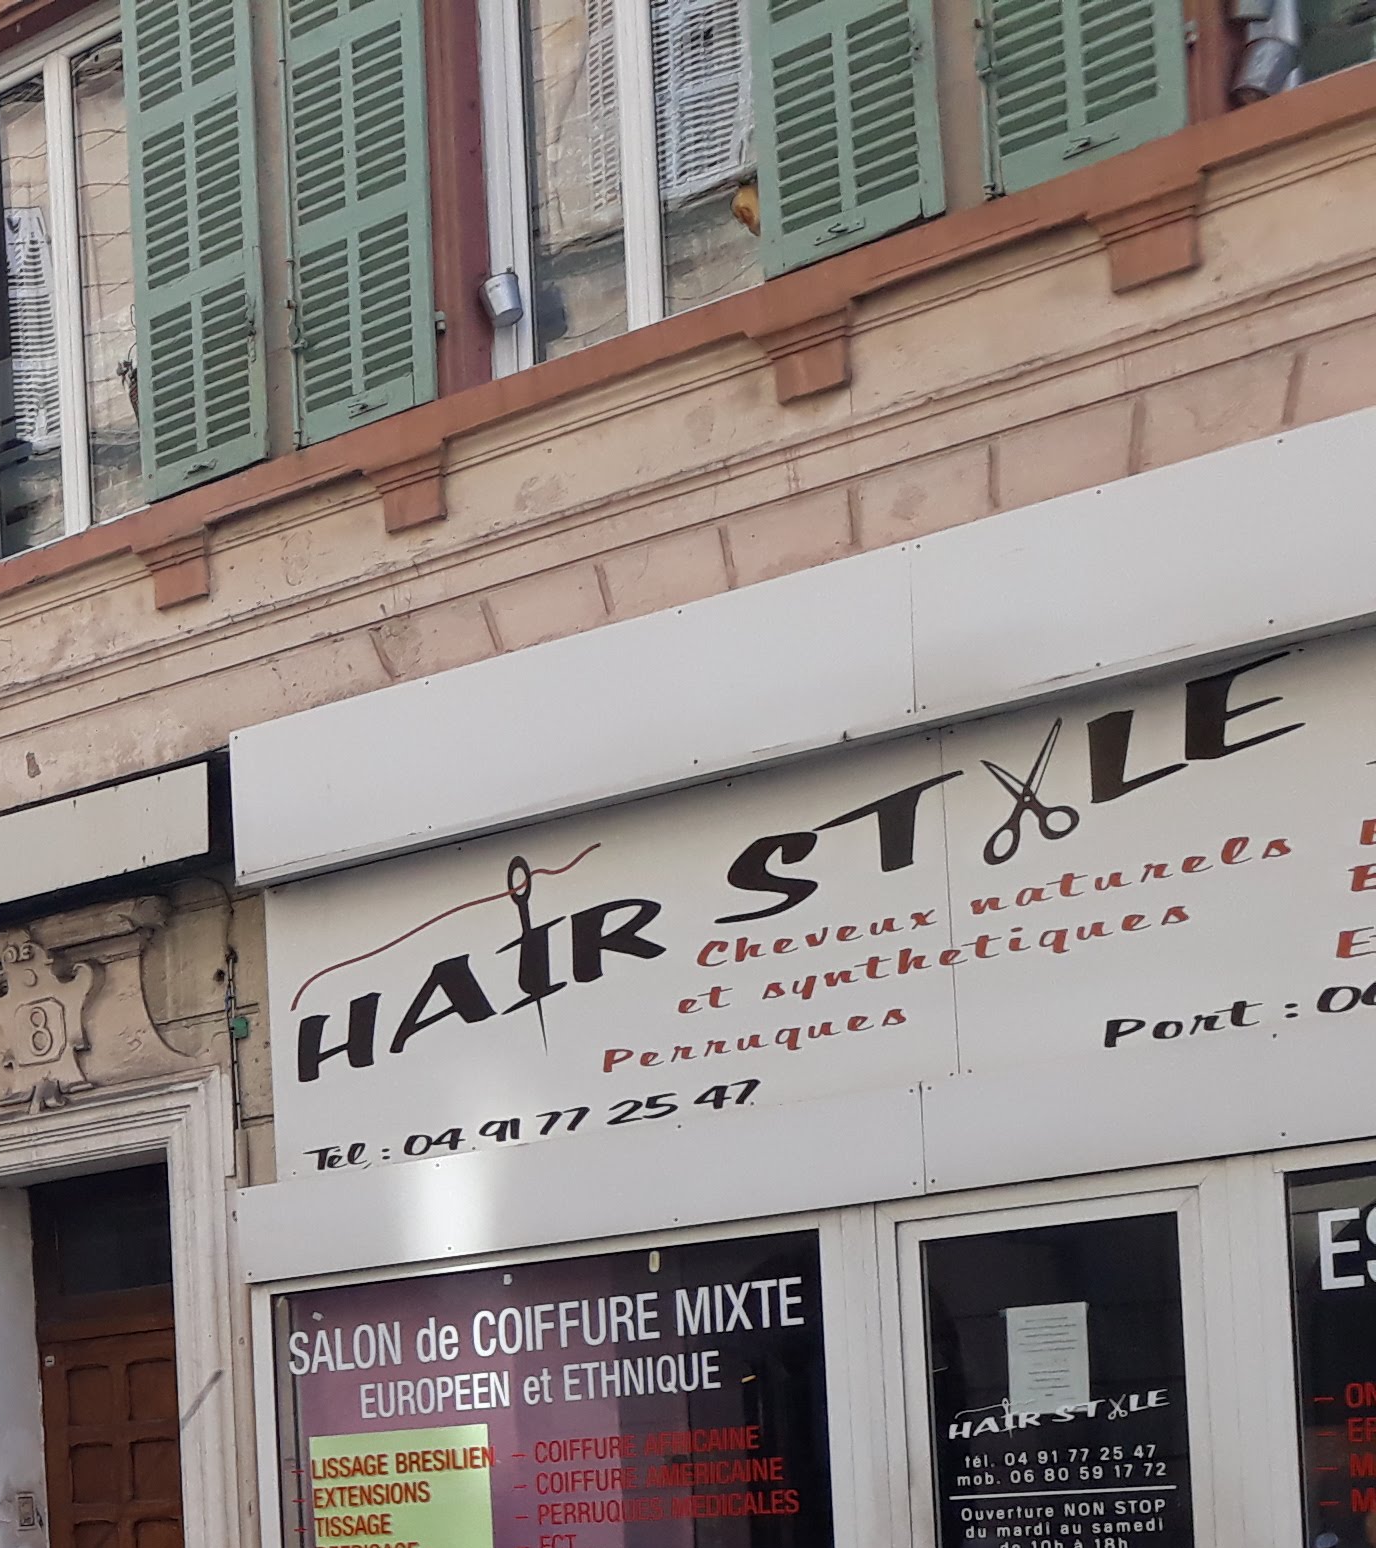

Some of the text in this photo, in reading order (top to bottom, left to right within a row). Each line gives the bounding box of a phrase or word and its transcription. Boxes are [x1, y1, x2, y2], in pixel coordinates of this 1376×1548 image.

[697, 836, 1292, 967] Cheveux naturels
[677, 905, 1190, 1014] et synthetiques
[298, 899, 667, 1083] HAIR
[29, 1006, 54, 1057] 8
[602, 1008, 908, 1074] Perruques
[288, 1276, 806, 1376] SALON de COIFFURE MIXTE
[359, 1350, 722, 1420] EUROPEEN et ETHNIQUE
[534, 1425, 761, 1464] COIFFURE AFRICAINE
[948, 1411, 1042, 1440] HAIR
[311, 1446, 496, 1480] LISSAGE BRESILIEN
[1004, 1452, 1028, 1466] 04
[1037, 1450, 1058, 1465] 91
[1068, 1448, 1090, 1463] 77
[1099, 1446, 1124, 1460] 25
[1133, 1444, 1157, 1459] 47
[535, 1456, 785, 1496] COIFFURE AMERICAINE
[956, 1462, 1167, 1487] mob. 06 80 59 17 72
[313, 1480, 431, 1509] EXTENSIONS
[537, 1489, 801, 1526] PERRUQUES MEDICALES
[960, 1498, 1167, 1522] Ouverture NON STOP
[315, 1513, 393, 1538] TISSAGE
[965, 1517, 1164, 1539] du mardi au samedi
